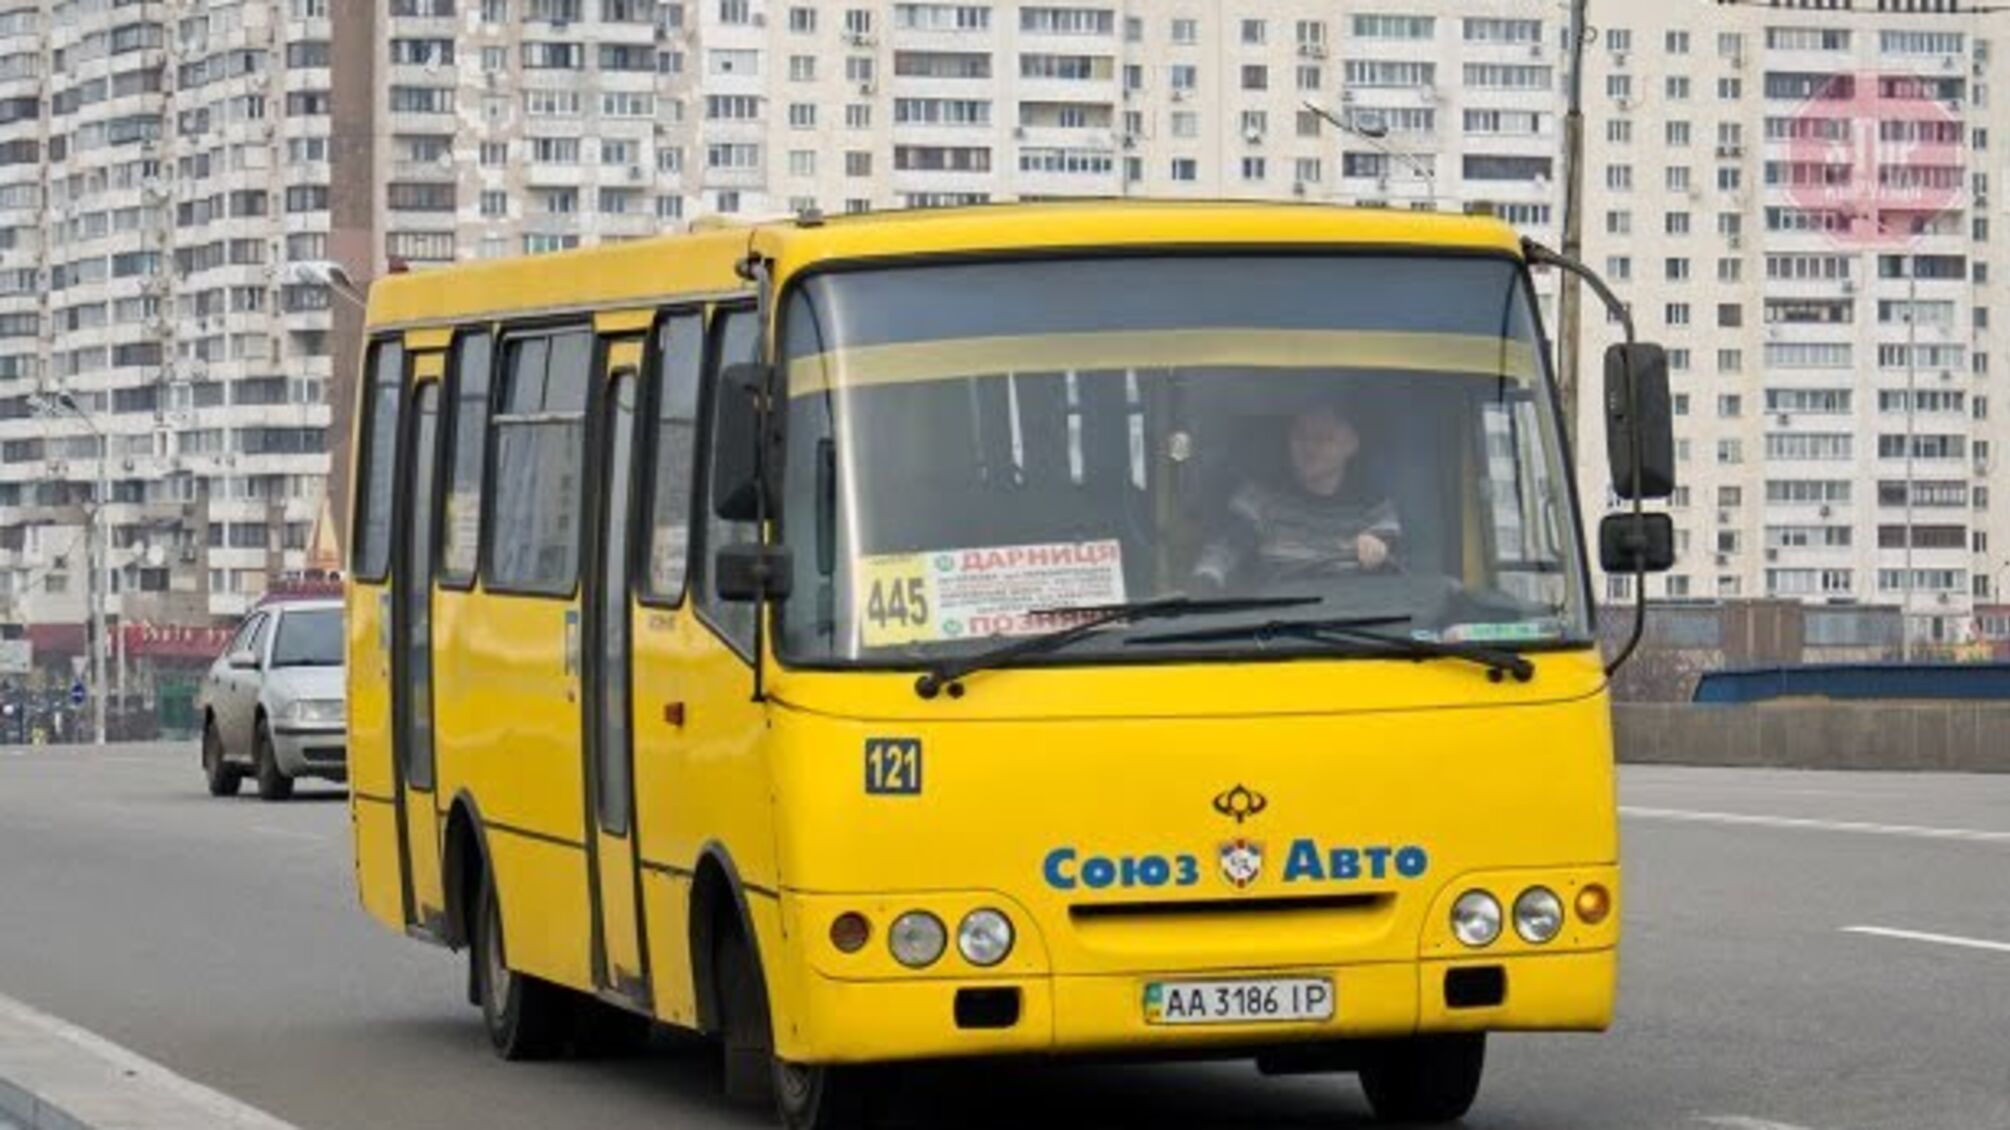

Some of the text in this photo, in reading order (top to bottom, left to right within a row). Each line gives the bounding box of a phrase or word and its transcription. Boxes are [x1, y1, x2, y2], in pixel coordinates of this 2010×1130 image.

[962, 545, 1117, 573] ДАРНИЦЯ
[867, 577, 928, 628] 445
[869, 743, 916, 788] 121
[1043, 847, 1200, 889] Союз
[1282, 838, 1428, 882] Авто
[1165, 984, 1327, 1017] AA 3186 IP
